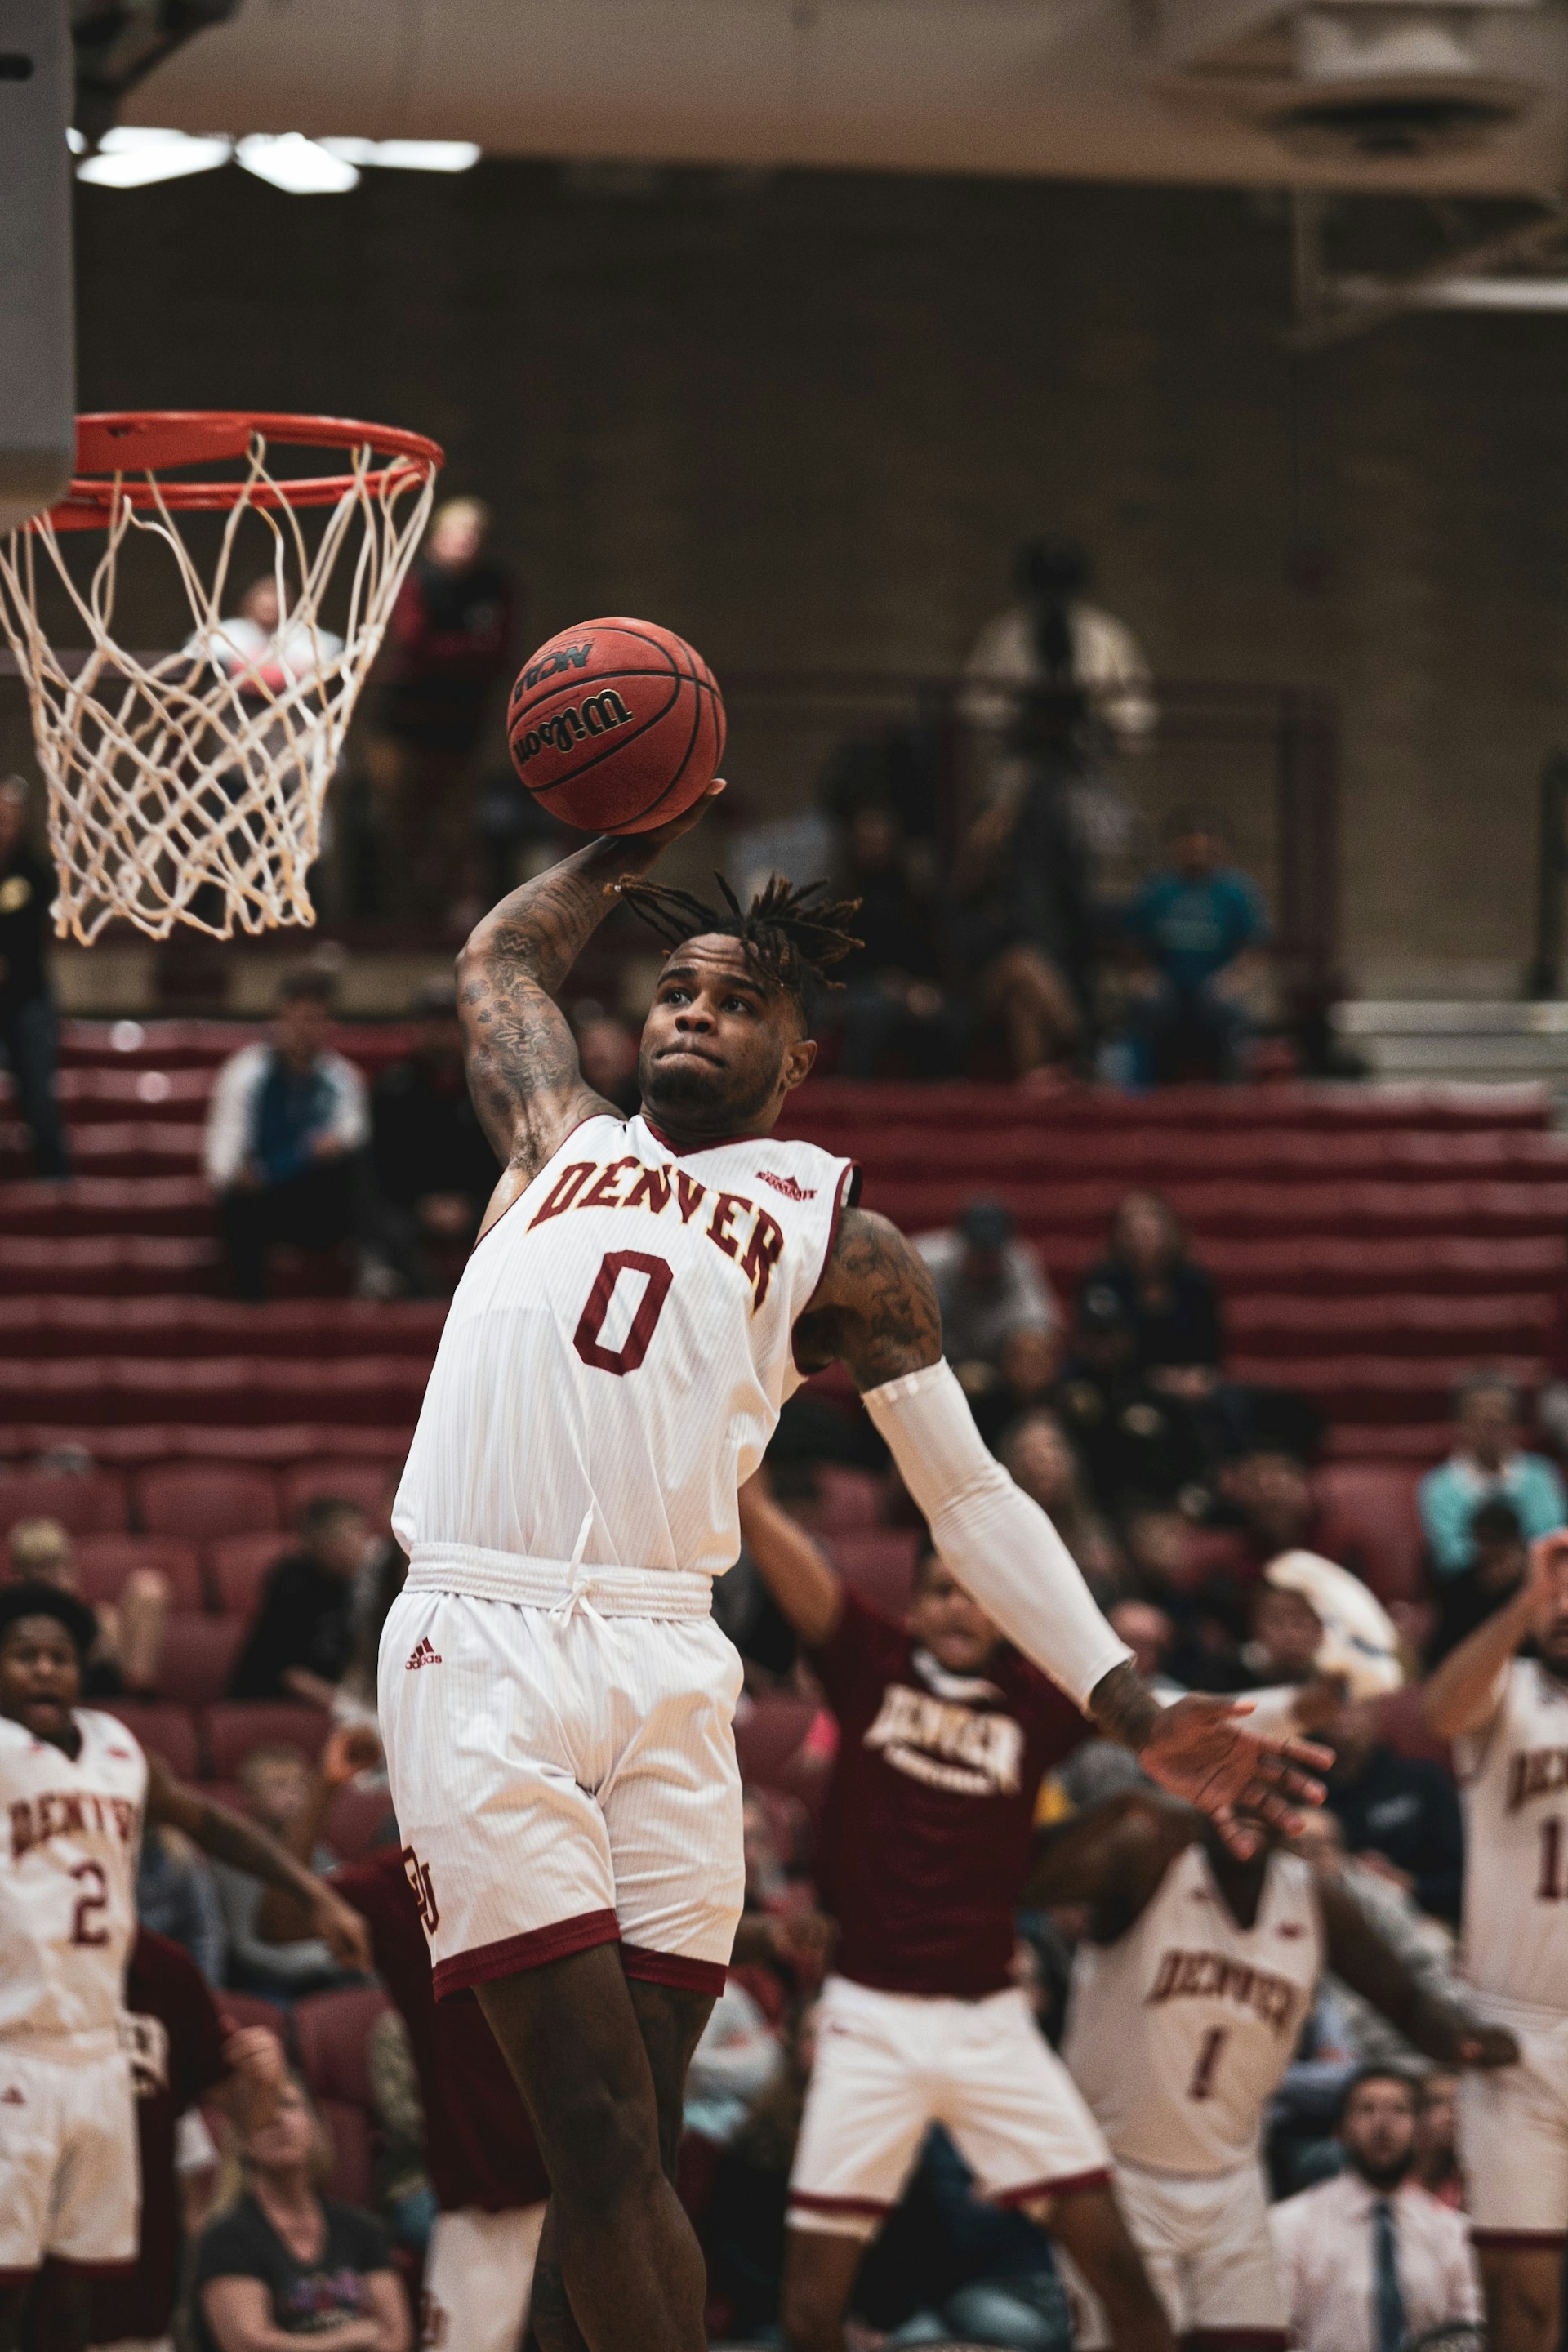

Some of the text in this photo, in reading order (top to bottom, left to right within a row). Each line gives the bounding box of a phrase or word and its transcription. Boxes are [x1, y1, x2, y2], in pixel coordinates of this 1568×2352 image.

[513, 643, 594, 704] NCAA
[513, 688, 635, 766] Wilson
[524, 1155, 786, 1319] DENVER
[572, 1248, 675, 1378] 0
[405, 1653, 442, 1670] addas
[10, 1792, 139, 1857] DENV
[70, 1859, 108, 1948] 2
[1145, 1949, 1298, 2040] DENVER
[1188, 2026, 1227, 2102] 1
